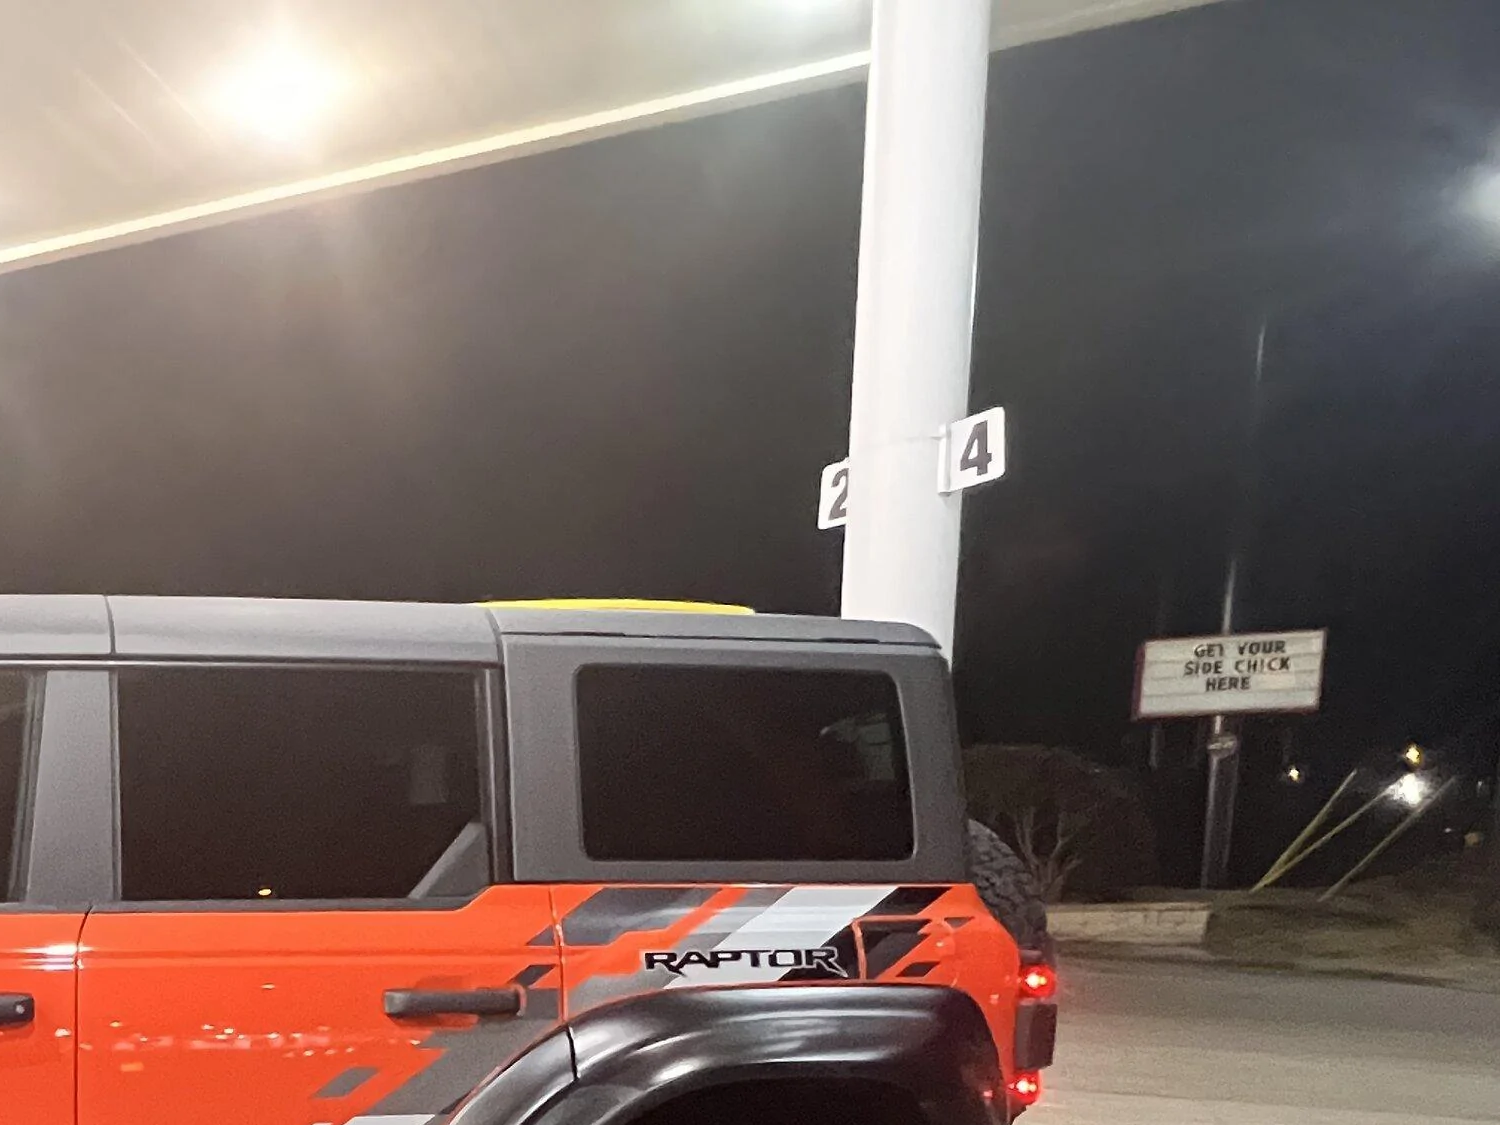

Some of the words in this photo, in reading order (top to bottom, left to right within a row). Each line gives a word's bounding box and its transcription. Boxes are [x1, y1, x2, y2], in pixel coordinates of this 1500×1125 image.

[960, 420, 992, 476] 4
[828, 467, 849, 521] 2
[1194, 643, 1224, 658] GET
[1238, 640, 1286, 656] YOUR
[1184, 661, 1223, 676] SIDE
[1234, 657, 1291, 674] CHICK
[1206, 676, 1251, 692] HERE
[644, 947, 849, 977] RAPTOR
